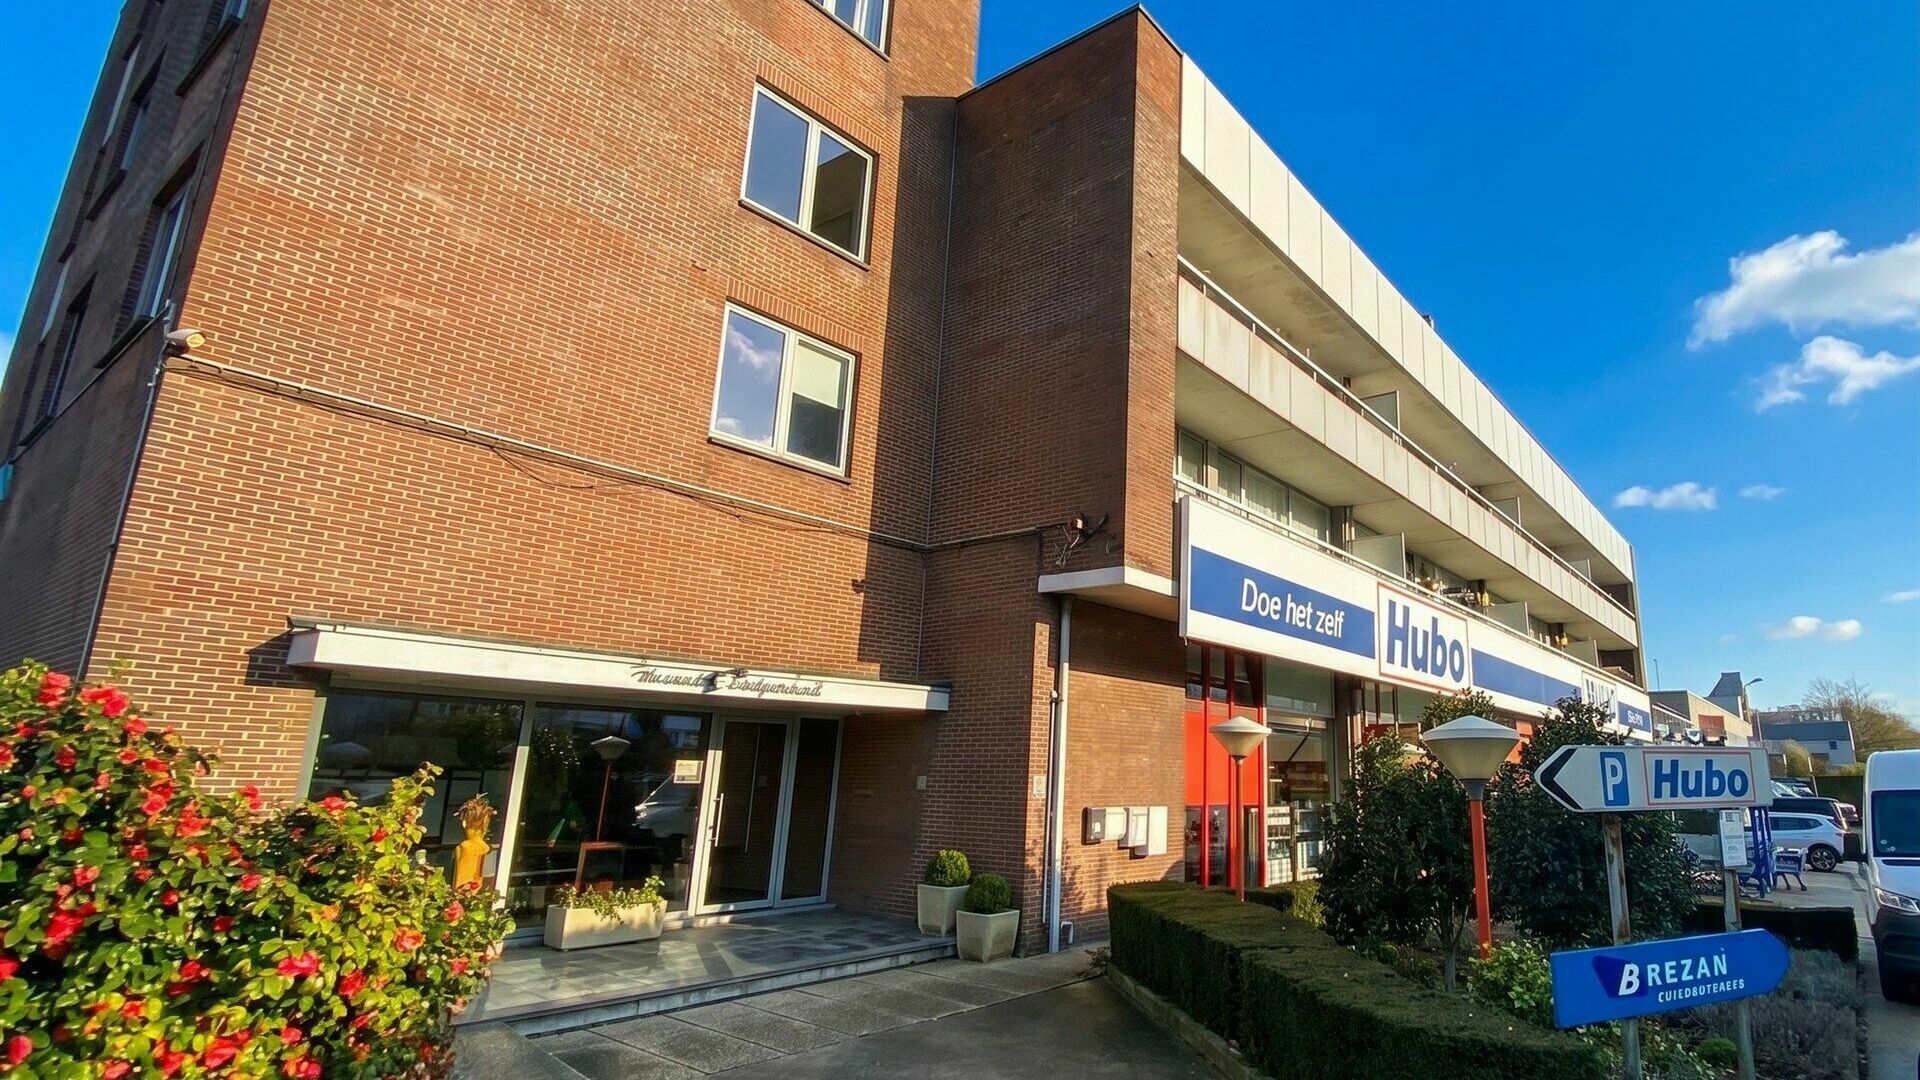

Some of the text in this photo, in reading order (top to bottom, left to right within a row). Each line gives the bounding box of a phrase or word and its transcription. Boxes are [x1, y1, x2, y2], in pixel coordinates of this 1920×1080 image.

[1241, 577, 1345, 638] Doe het zelf
[1386, 598, 1465, 683] Hubo
[1604, 757, 1749, 801] P Hubo
